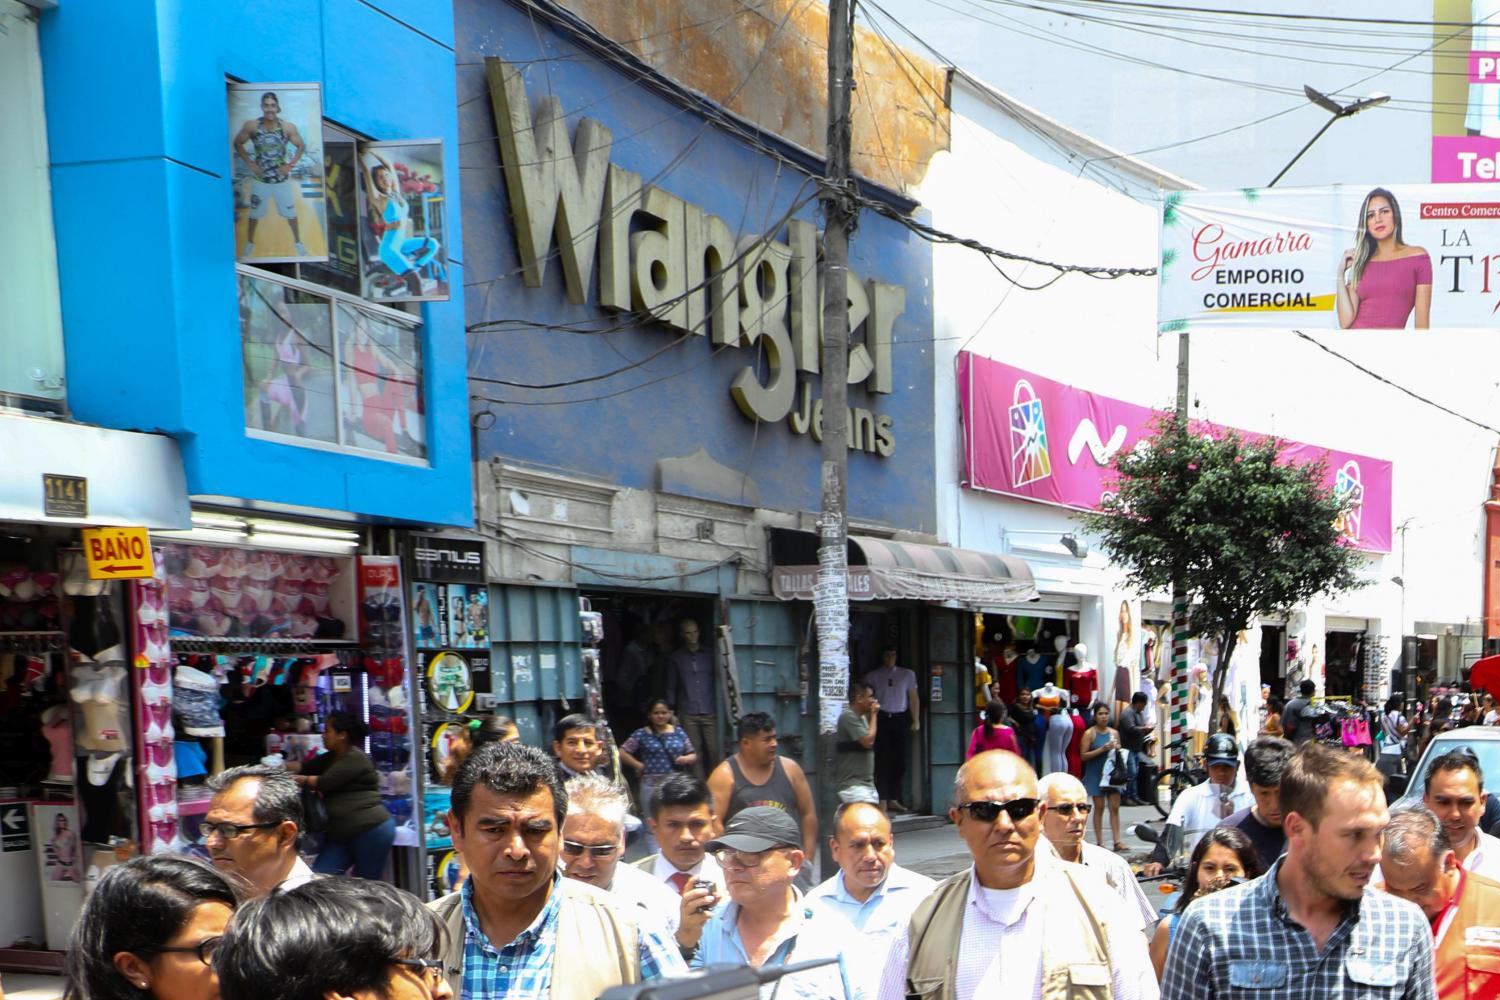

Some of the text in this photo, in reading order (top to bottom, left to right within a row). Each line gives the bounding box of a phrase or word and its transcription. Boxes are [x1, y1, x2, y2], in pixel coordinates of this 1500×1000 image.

[1423, 205, 1458, 216] Centro
[484, 56, 907, 422] Wrangler
[1441, 229, 1472, 247] LA
[1191, 224, 1314, 281] Gamarra
[1215, 269, 1304, 284] EMPORIO
[1203, 292, 1317, 309] COMERCIAL
[45, 478, 86, 501] 1141
[89, 532, 145, 562] BAÑO
